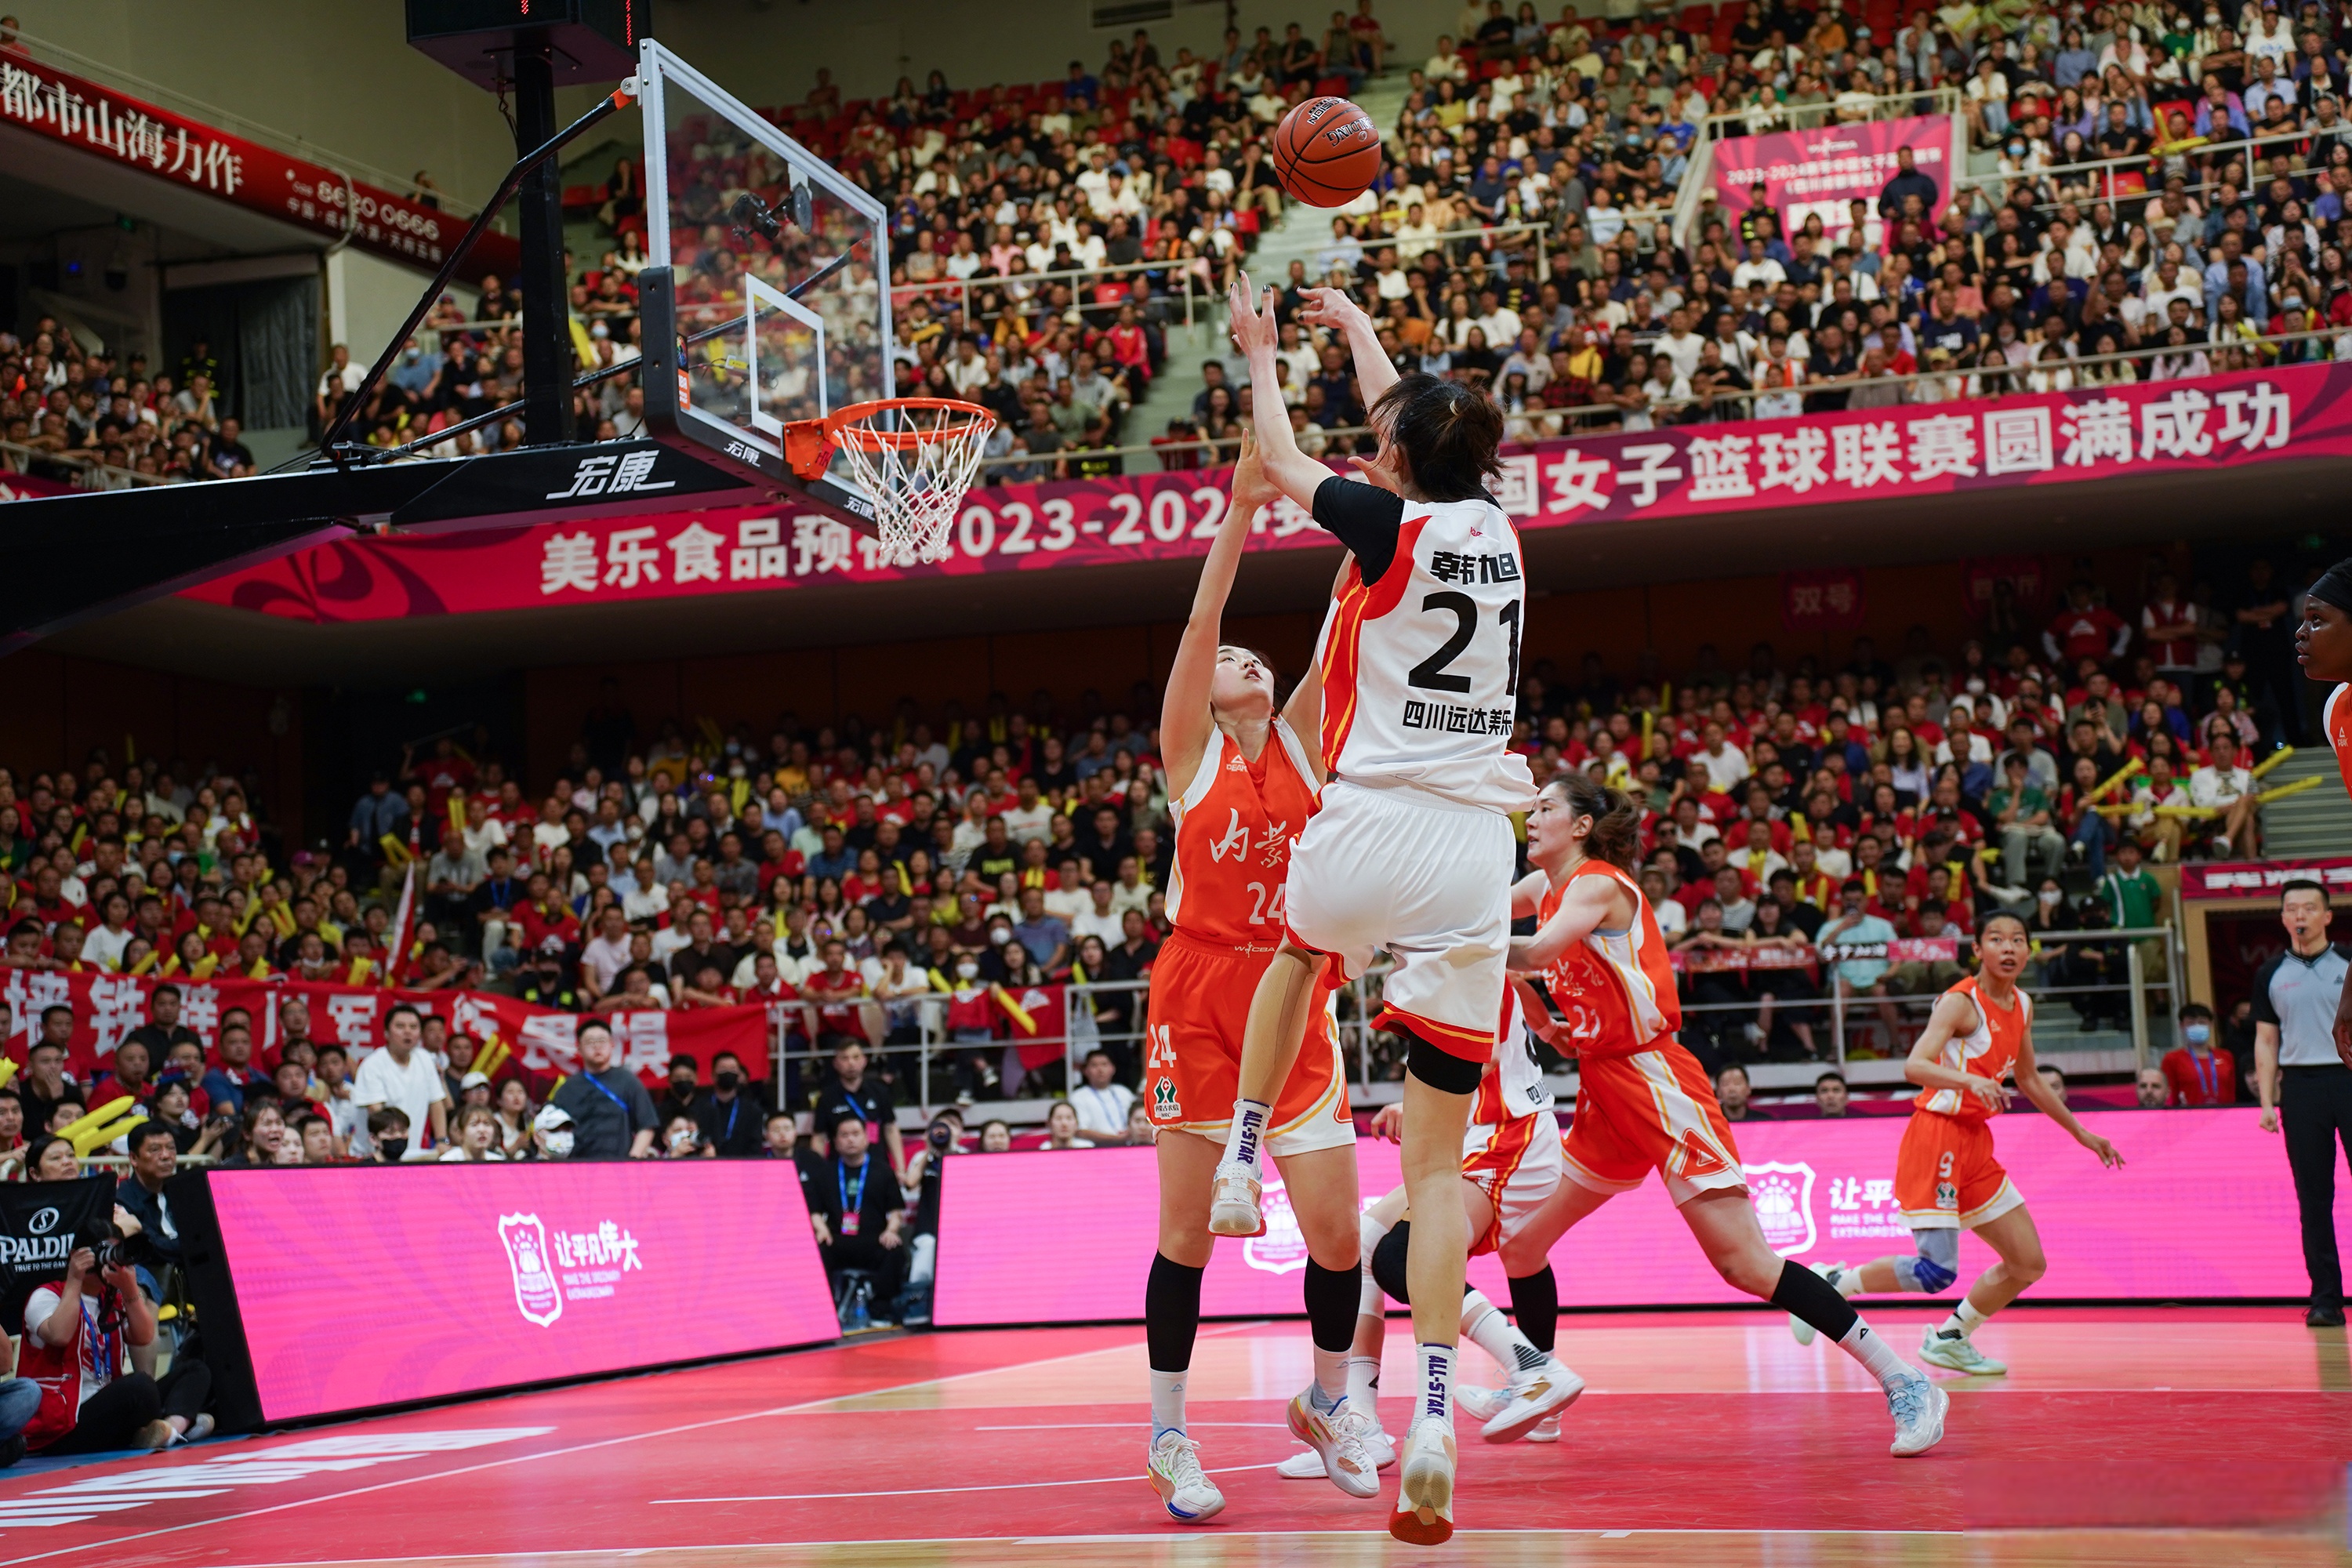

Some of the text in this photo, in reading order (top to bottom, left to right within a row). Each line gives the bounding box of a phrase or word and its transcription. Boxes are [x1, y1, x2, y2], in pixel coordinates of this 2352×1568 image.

[0, 62, 243, 195] 都市山海力作
[1429, 550, 1521, 585] 韩旭
[1408, 591, 1520, 697] 21
[1403, 700, 1513, 735] 四川远达美乐
[1247, 882, 1286, 926] 24
[1149, 1023, 1177, 1068] 24
[1237, 1109, 1264, 1165] ALL-STAR
[14, 1264, 32, 1272] TRUE
[41, 1261, 53, 1270] THE
[554, 1219, 643, 1272] 让平凡伟大
[1426, 1355, 1447, 1417] ALL-STAR
